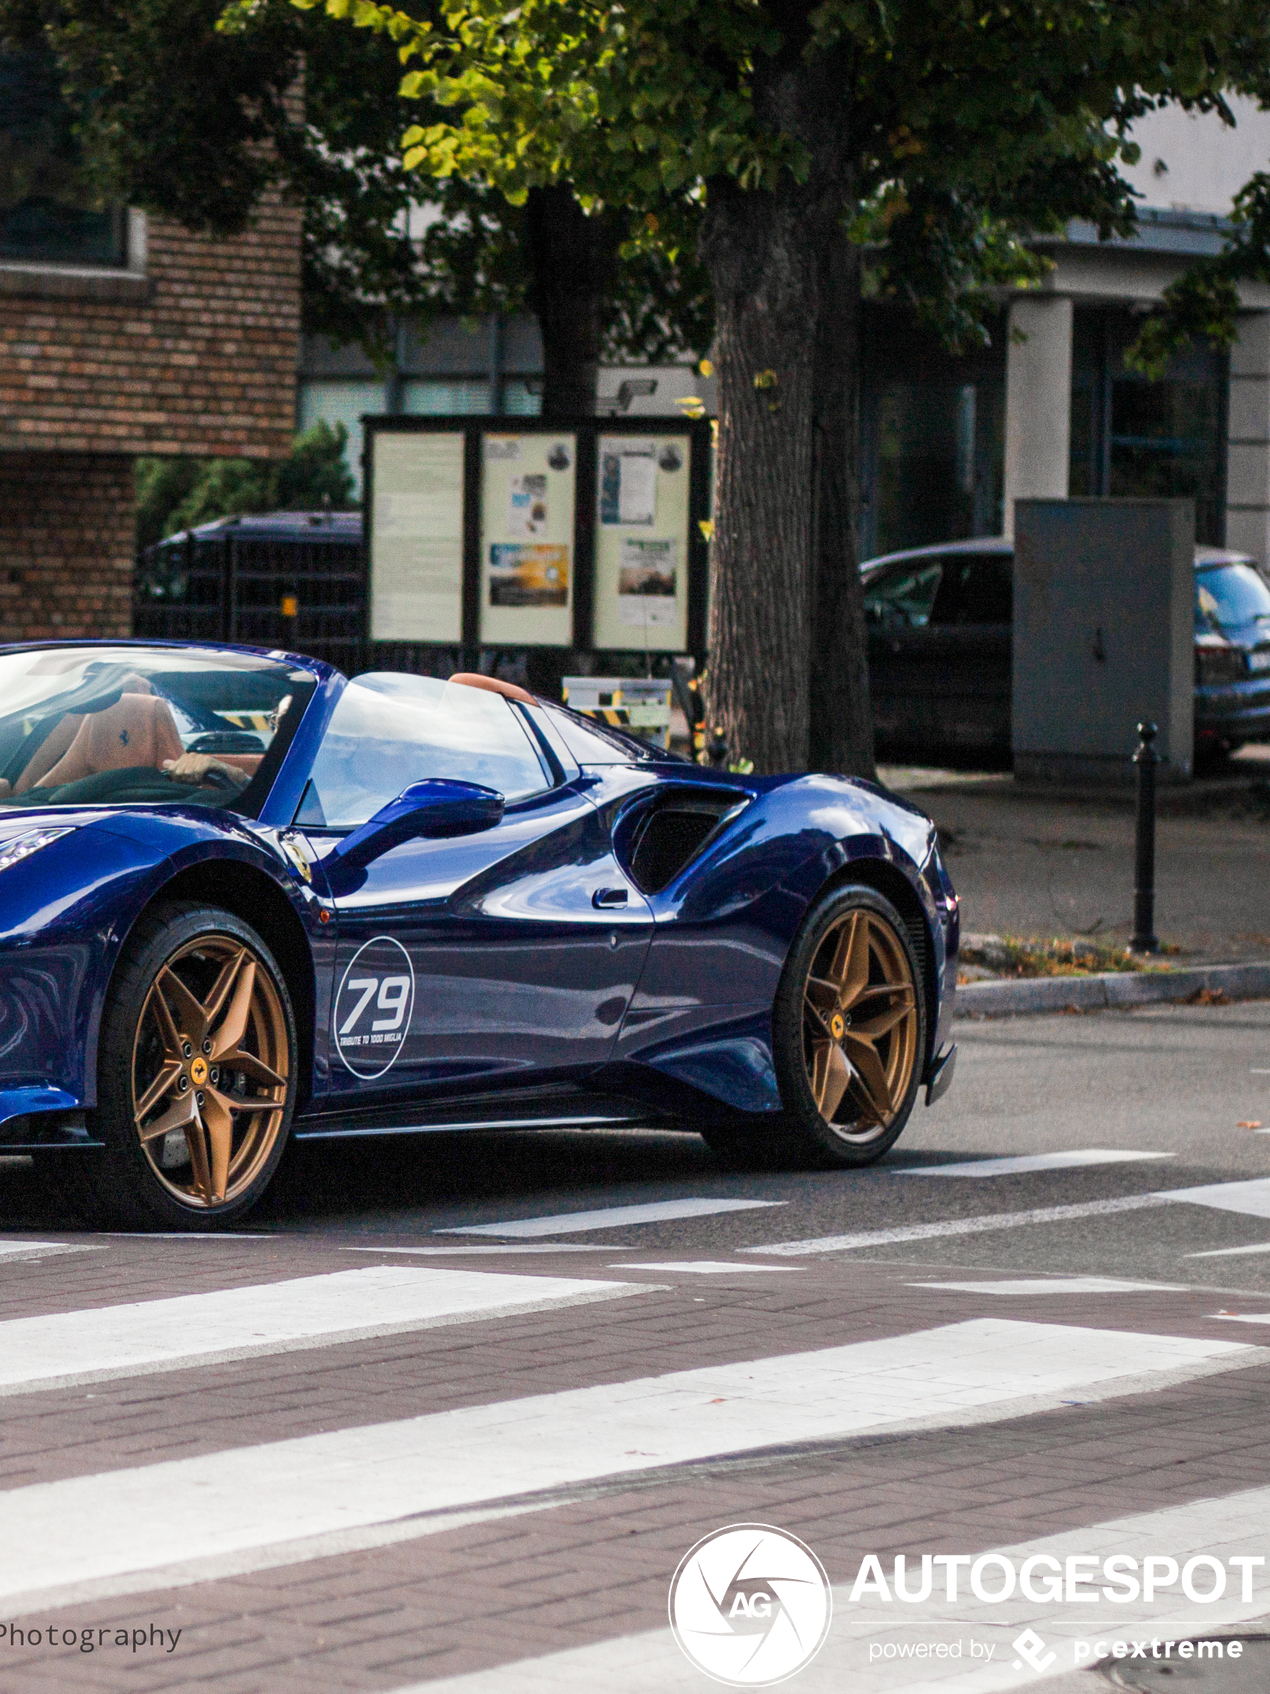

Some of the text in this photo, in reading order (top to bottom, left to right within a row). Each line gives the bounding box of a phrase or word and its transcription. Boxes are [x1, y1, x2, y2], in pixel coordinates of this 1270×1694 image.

[338, 976, 410, 1034] 79
[340, 1032, 402, 1046] TRIBUTE TO 1000 MIGLIA
